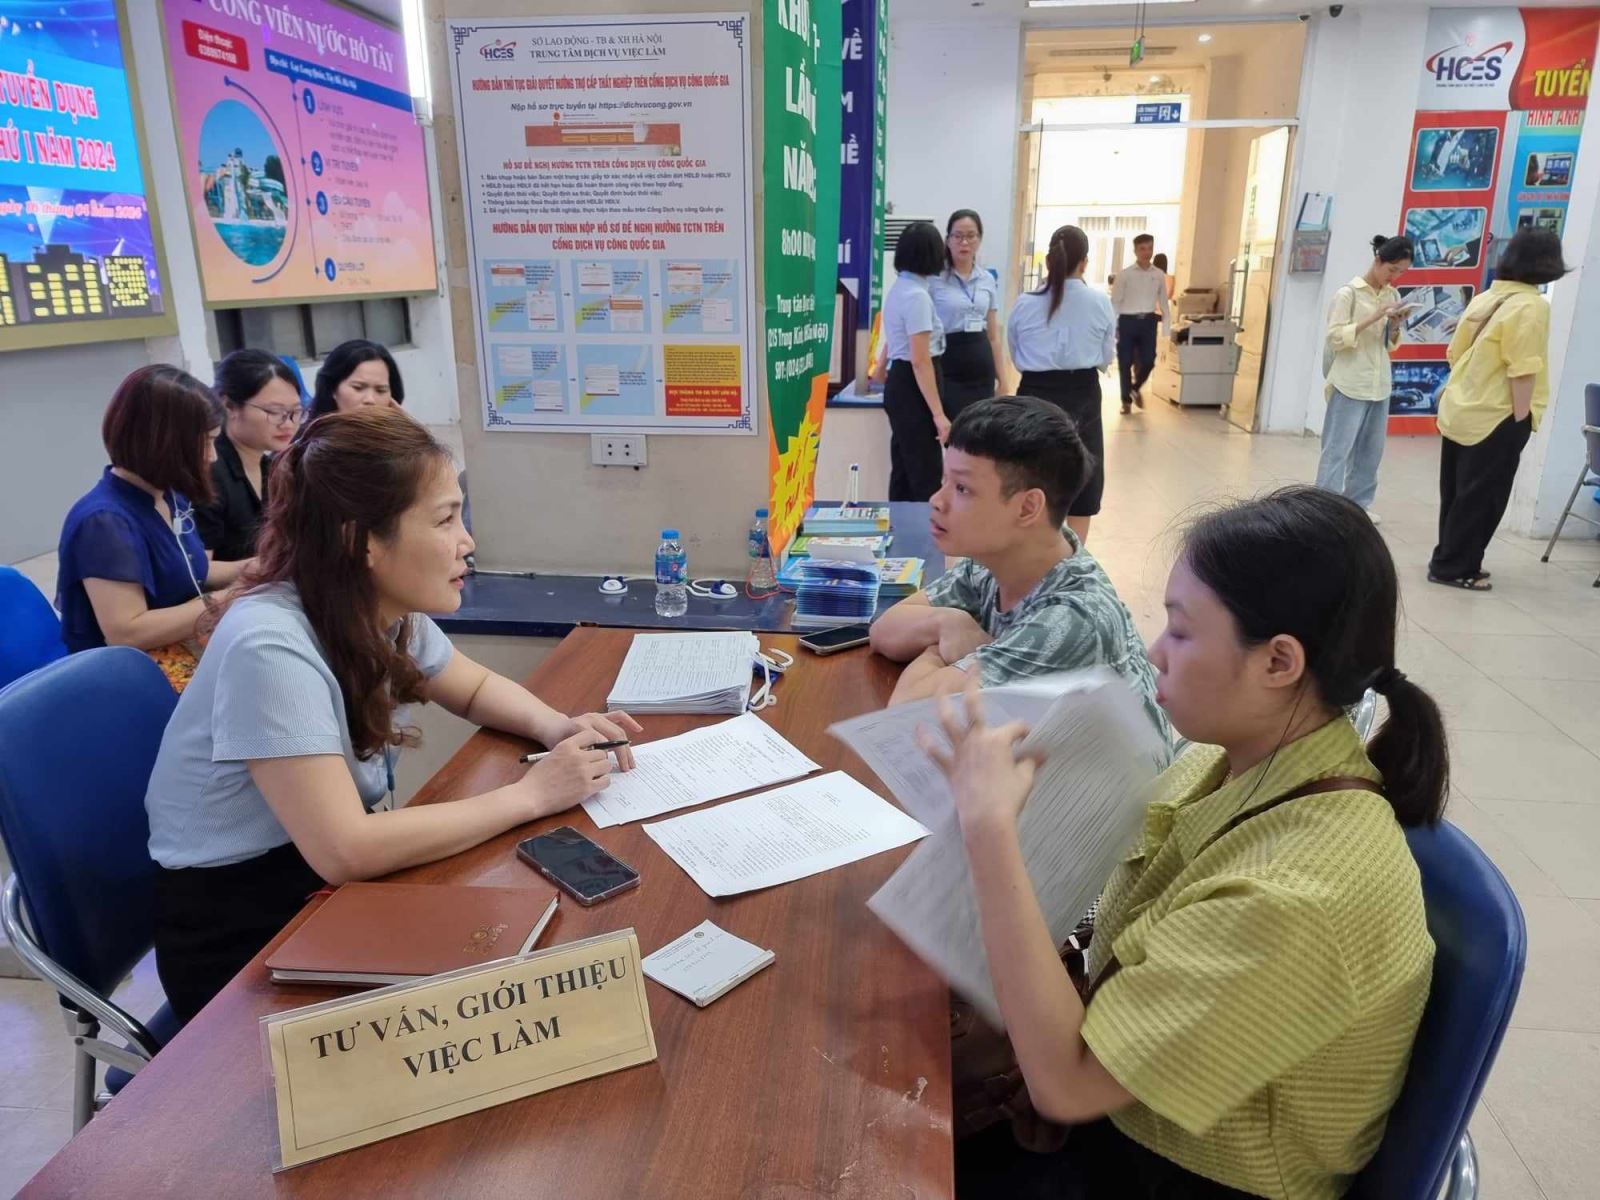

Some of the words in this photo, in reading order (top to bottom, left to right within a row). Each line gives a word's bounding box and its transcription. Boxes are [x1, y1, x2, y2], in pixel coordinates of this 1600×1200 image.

[545, 36, 563, 45] LAO
[564, 34, 589, 46] ĐỘNG
[596, 36, 607, 45] TB
[618, 35, 630, 44] XH
[632, 33, 645, 44] HÀ
[646, 33, 663, 44] NỘI
[484, 48, 515, 59] HCES
[530, 50, 561, 59] TRUNG
[562, 47, 582, 57] TÂM
[583, 48, 606, 59] DỊCH
[607, 48, 620, 58] VỤ
[622, 47, 644, 58] VIỆC
[645, 45, 667, 56] LÀM
[1436, 56, 1502, 81] HCES
[54, 80, 99, 125] DỤNG
[76, 137, 117, 172] 2024
[538, 223, 553, 234] QUY
[683, 222, 702, 232] TCTN
[704, 220, 725, 232] TRÊN
[575, 239, 593, 252] DỊCH
[595, 239, 605, 252] VỤ
[606, 238, 628, 250] CÔNG
[652, 239, 665, 250] GIA
[310, 1020, 361, 1059] TƯ
[369, 1004, 449, 1042] VẤN,
[456, 980, 526, 1020] GIỚI
[534, 956, 627, 999] THIỆU
[402, 1037, 483, 1079] VIỆC
[491, 1016, 562, 1056] LÀM
